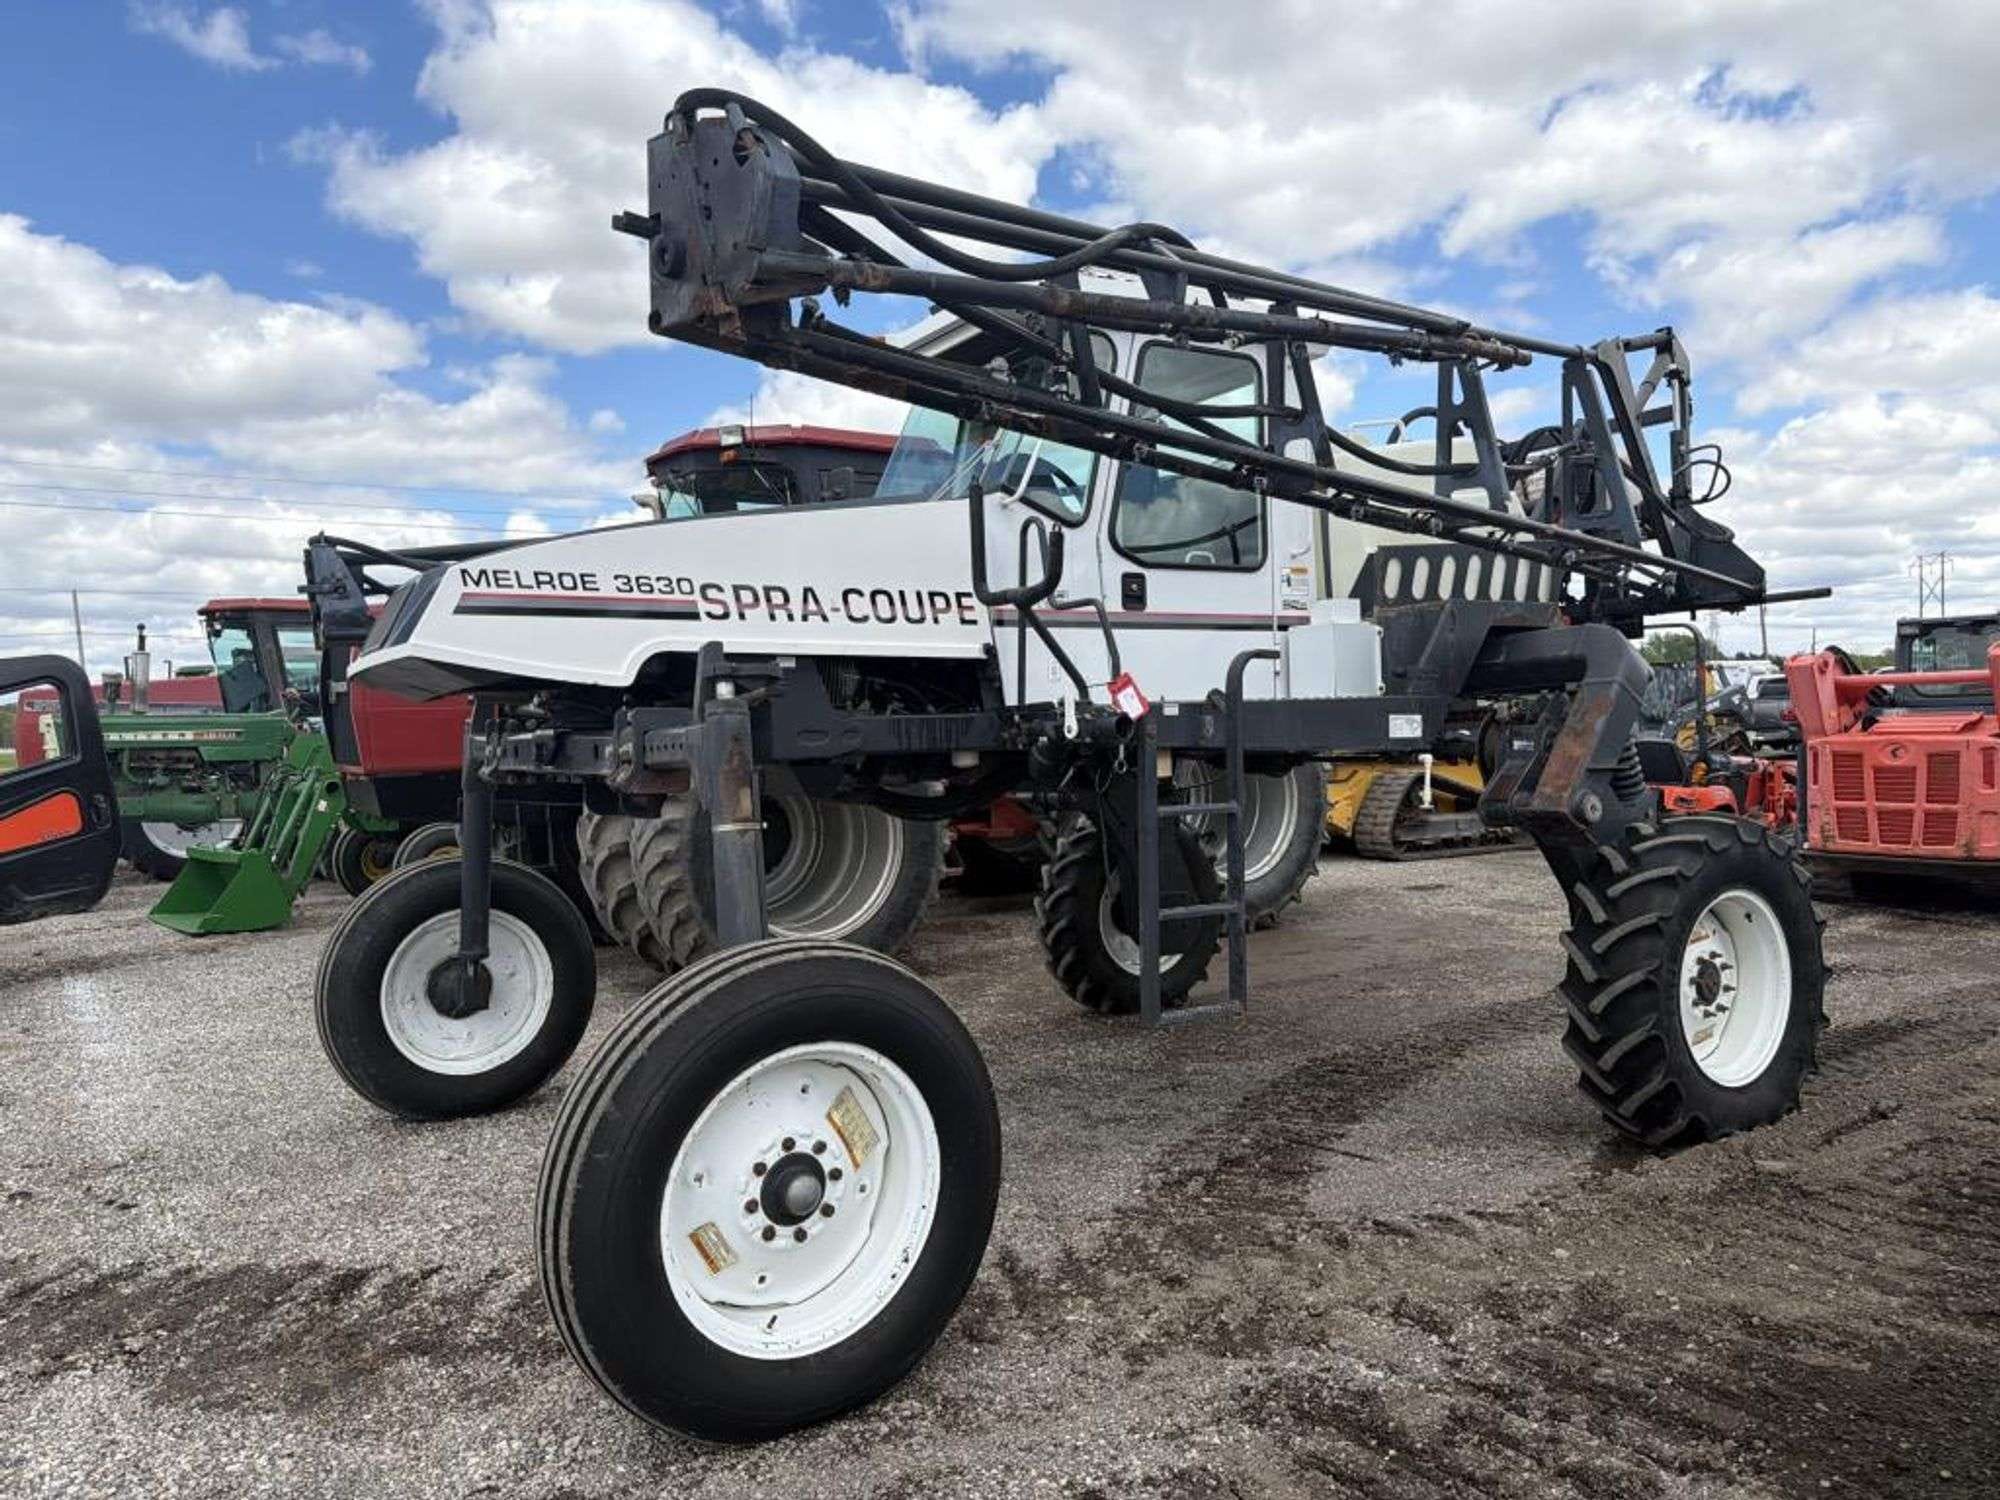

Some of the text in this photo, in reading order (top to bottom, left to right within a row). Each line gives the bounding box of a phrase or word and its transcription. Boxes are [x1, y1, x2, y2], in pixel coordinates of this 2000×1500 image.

[460, 568, 695, 595] MELROE 3630
[700, 583, 978, 625] SPRA-COUPE
